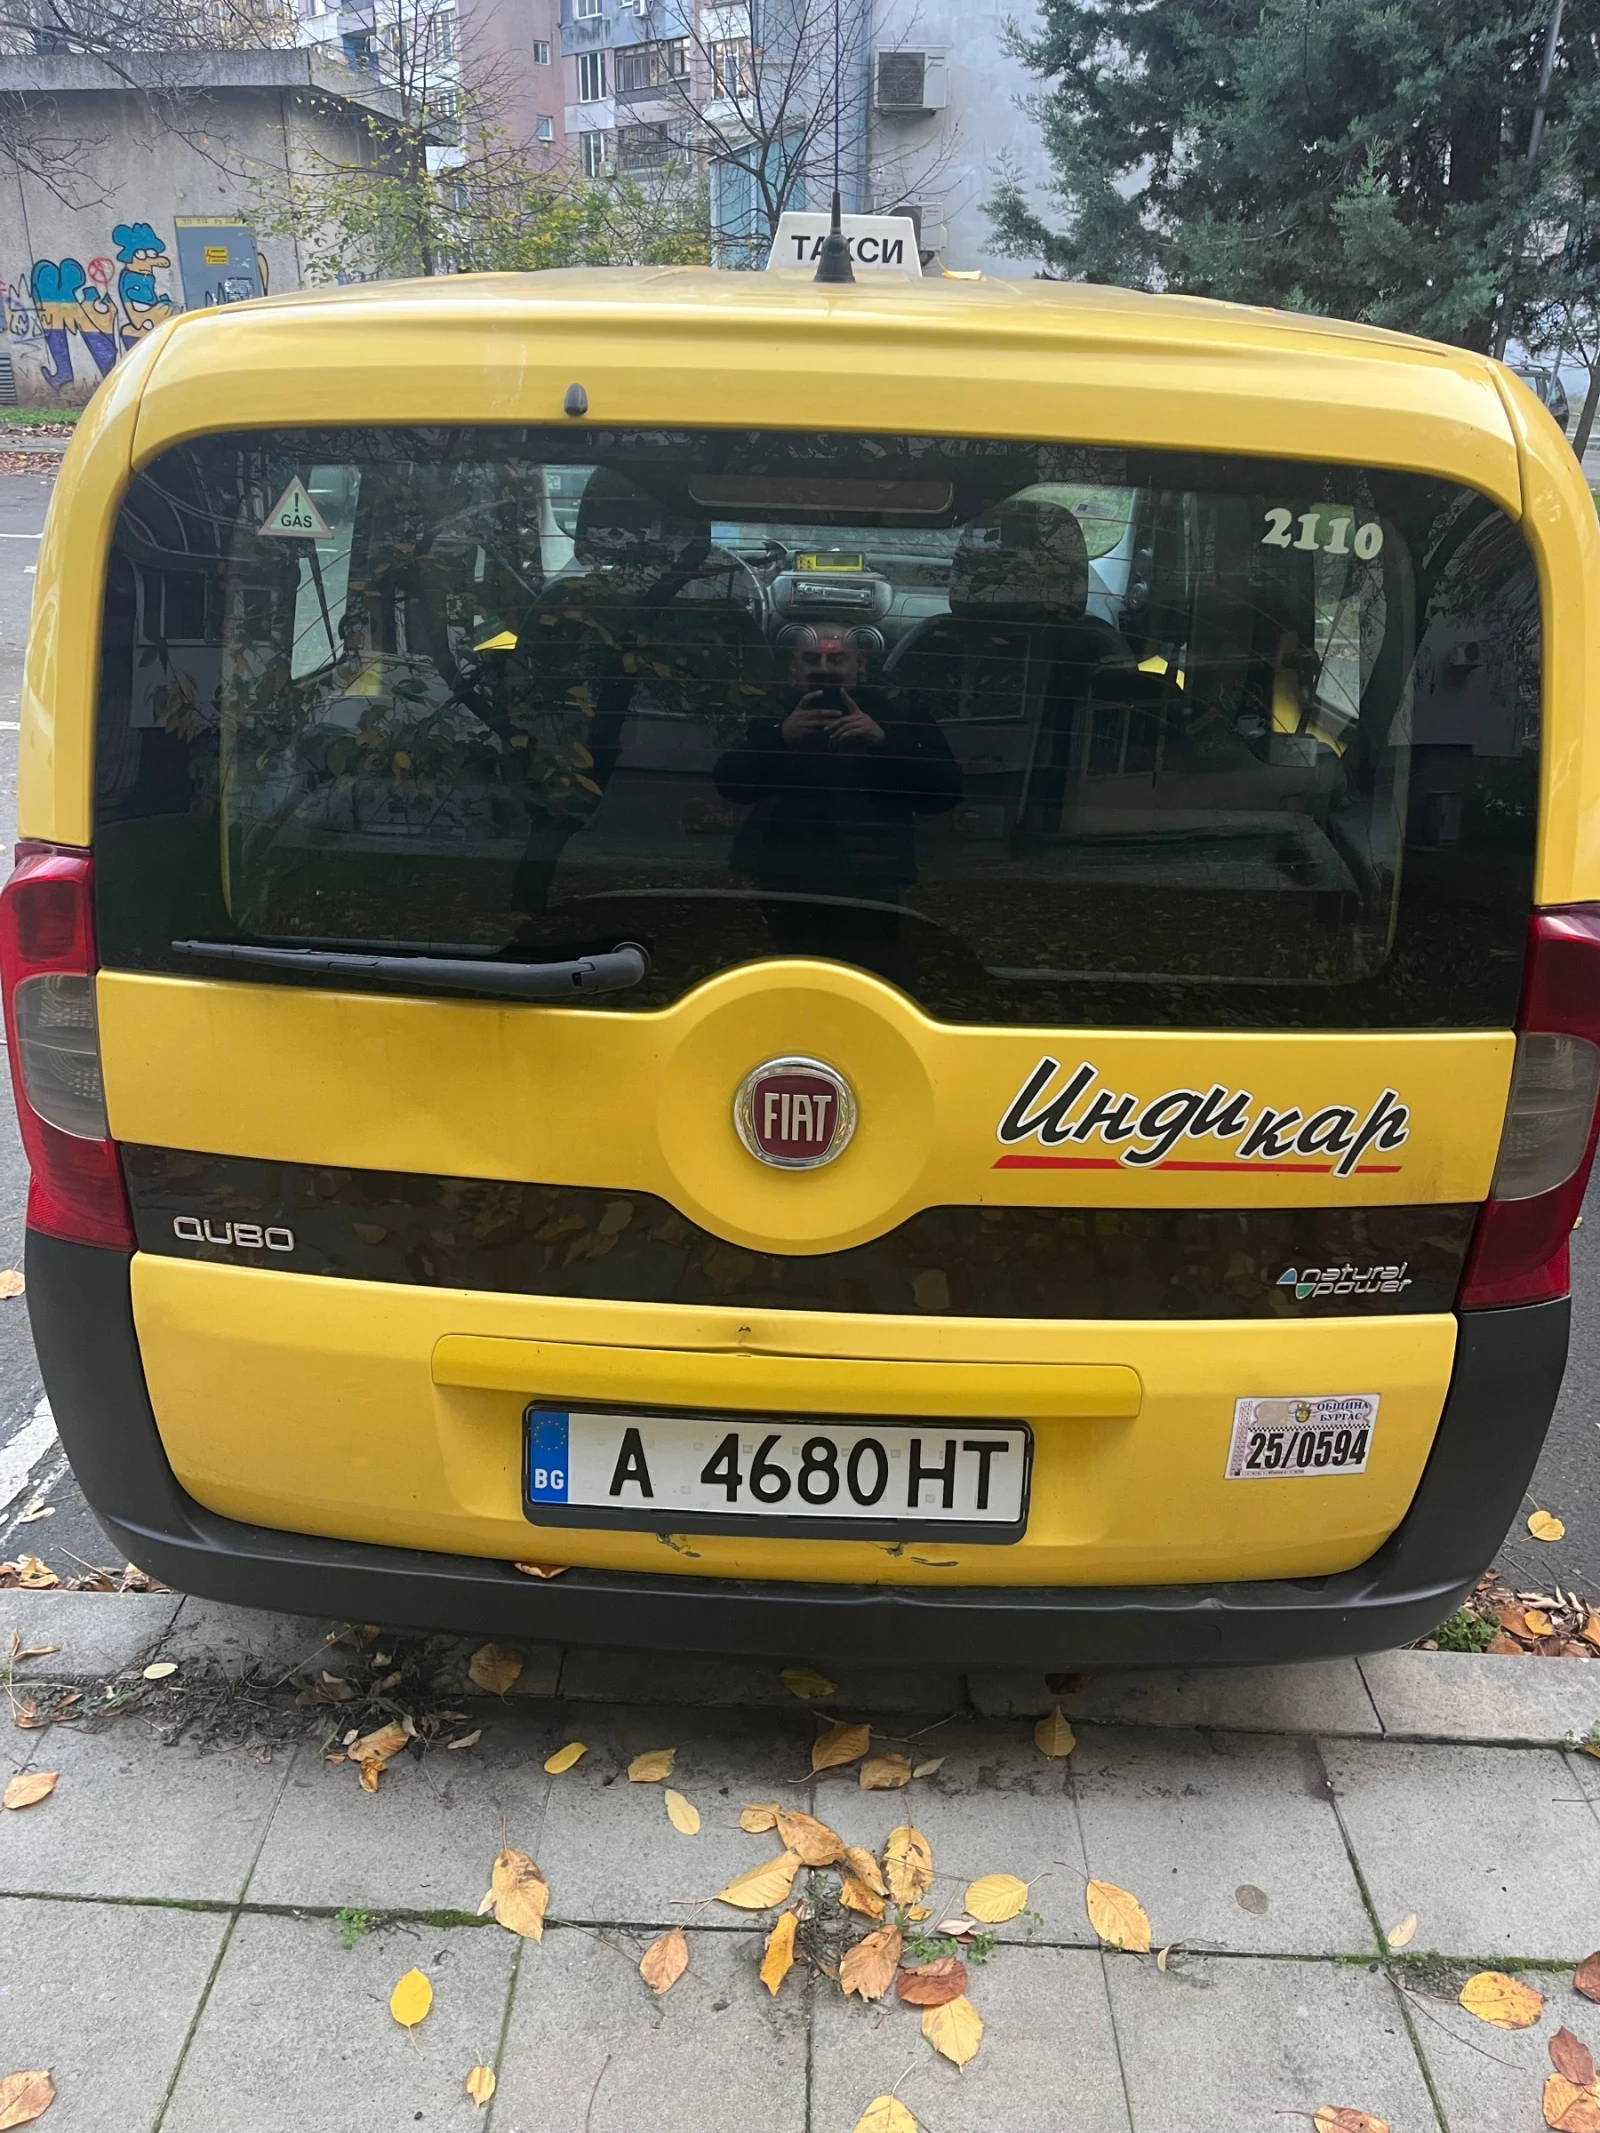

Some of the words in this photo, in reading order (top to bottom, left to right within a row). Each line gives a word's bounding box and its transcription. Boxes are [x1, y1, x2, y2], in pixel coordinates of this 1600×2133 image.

[281, 514, 313, 528] GAS
[1261, 507, 1384, 560] 2110
[764, 1092, 832, 1142] FIAT
[997, 1056, 1409, 1177] Индикар
[173, 1216, 295, 1252] QUBO
[1301, 1262, 1408, 1282] natural
[1312, 1279, 1412, 1298] power
[1317, 1401, 1369, 1411] ОБЩИНА
[1320, 1412, 1363, 1422] БУРГАС
[1246, 1429, 1369, 1469] 25/0594
[534, 1468, 565, 1491] BG
